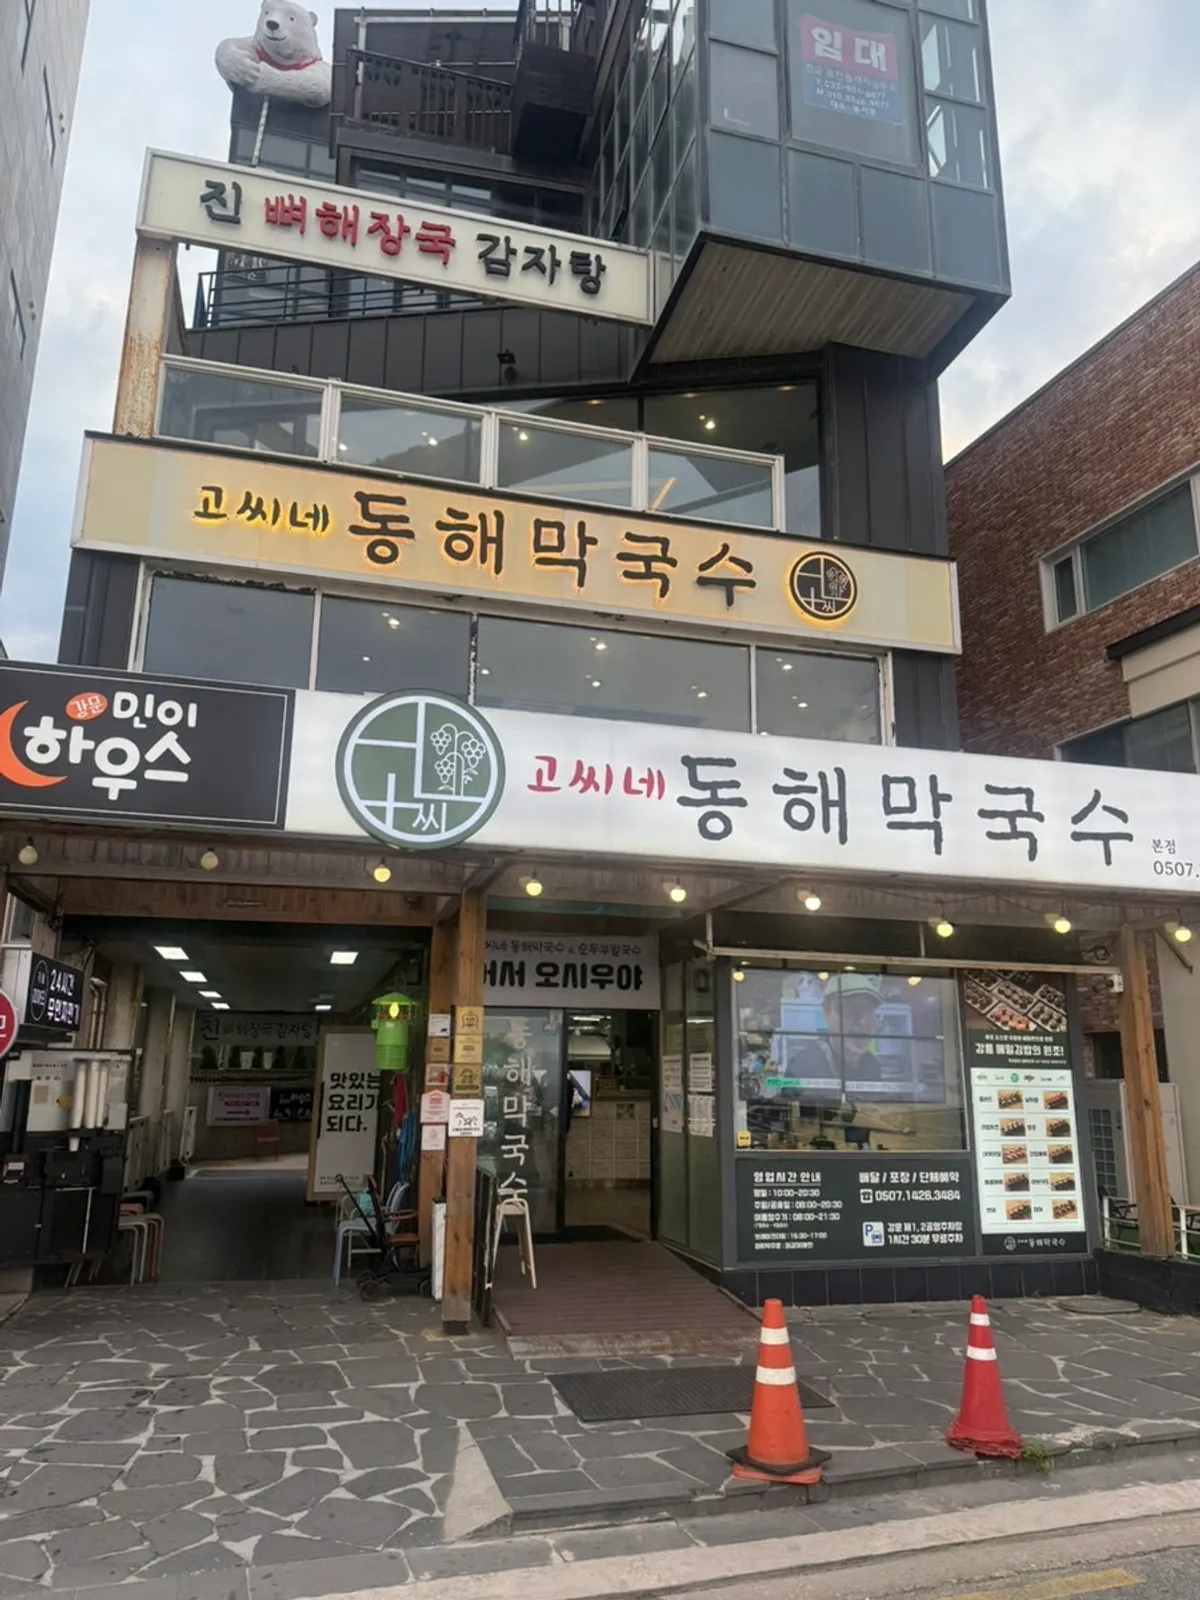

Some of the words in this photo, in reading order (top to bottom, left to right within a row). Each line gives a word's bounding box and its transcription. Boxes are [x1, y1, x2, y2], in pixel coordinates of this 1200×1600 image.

[200, 180, 242, 224] 진
[263, 194, 456, 266] 뼈해장국
[476, 232, 607, 296] 감자탕
[193, 485, 330, 534] 고씨네
[348, 489, 757, 611] 동해막국수
[112, 690, 198, 728] 민이
[23, 715, 192, 801] 하우스
[526, 754, 667, 801] 고씨네
[676, 754, 1134, 867] 동해막국수
[1151, 838, 1176, 855] 본점
[535, 961, 643, 991] 오시우야
[330, 1071, 381, 1090] 맛있는
[497, 1017, 534, 1200] 동해막국수
[325, 1115, 368, 1133] 되다.
[753, 1171, 797, 1183] 영업시간
[799, 1171, 822, 1183] 안내
[859, 1171, 881, 1184] 배달
[889, 1171, 910, 1184] 포장
[919, 1171, 960, 1184] 단체예약
[888, 1234, 910, 1245] 1시간
[911, 1234, 930, 1245] 30분
